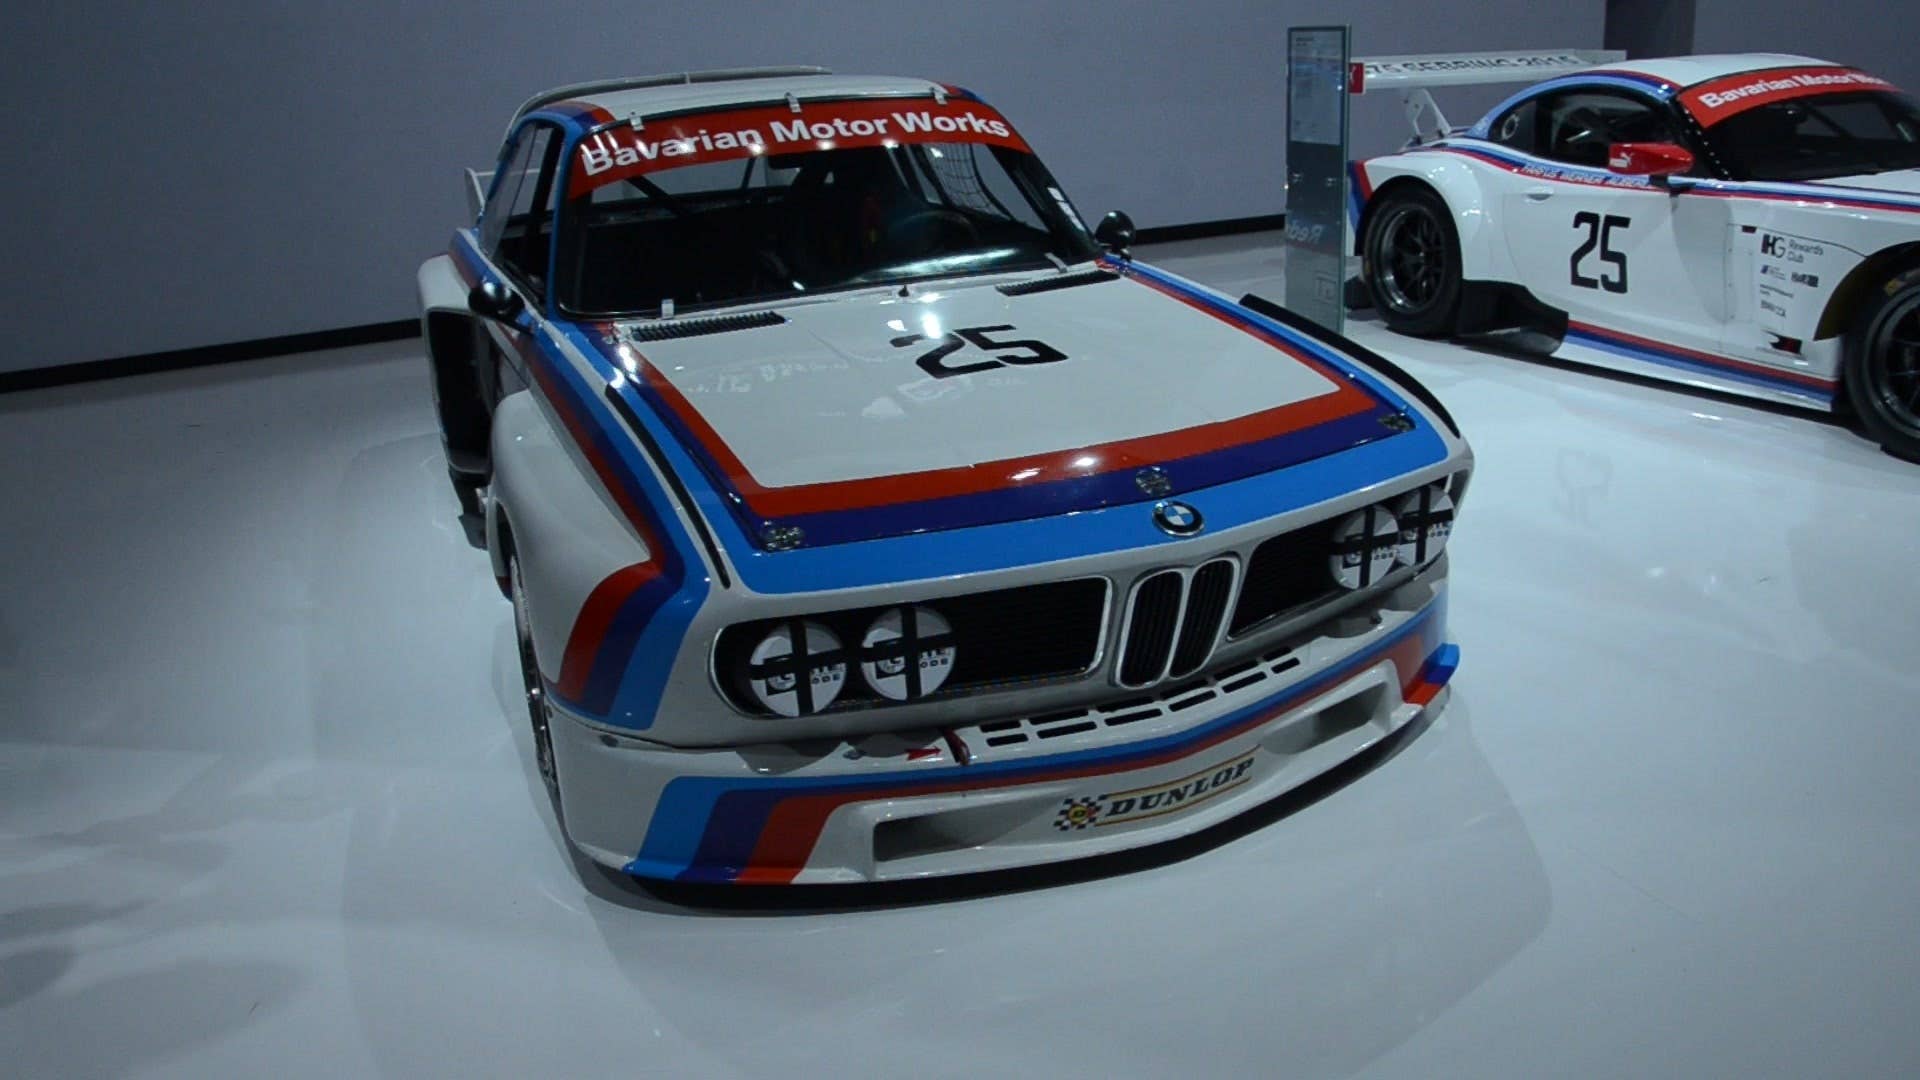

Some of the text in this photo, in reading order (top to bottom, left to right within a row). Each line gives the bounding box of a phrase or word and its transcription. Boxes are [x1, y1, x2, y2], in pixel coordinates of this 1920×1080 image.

[1699, 75, 1800, 108] Bavarian
[580, 110, 1011, 177] Bavarian Motor Works
[1570, 210, 1632, 295] 25
[889, 323, 1069, 379] 25
[1106, 757, 1255, 818] DUNLOP
